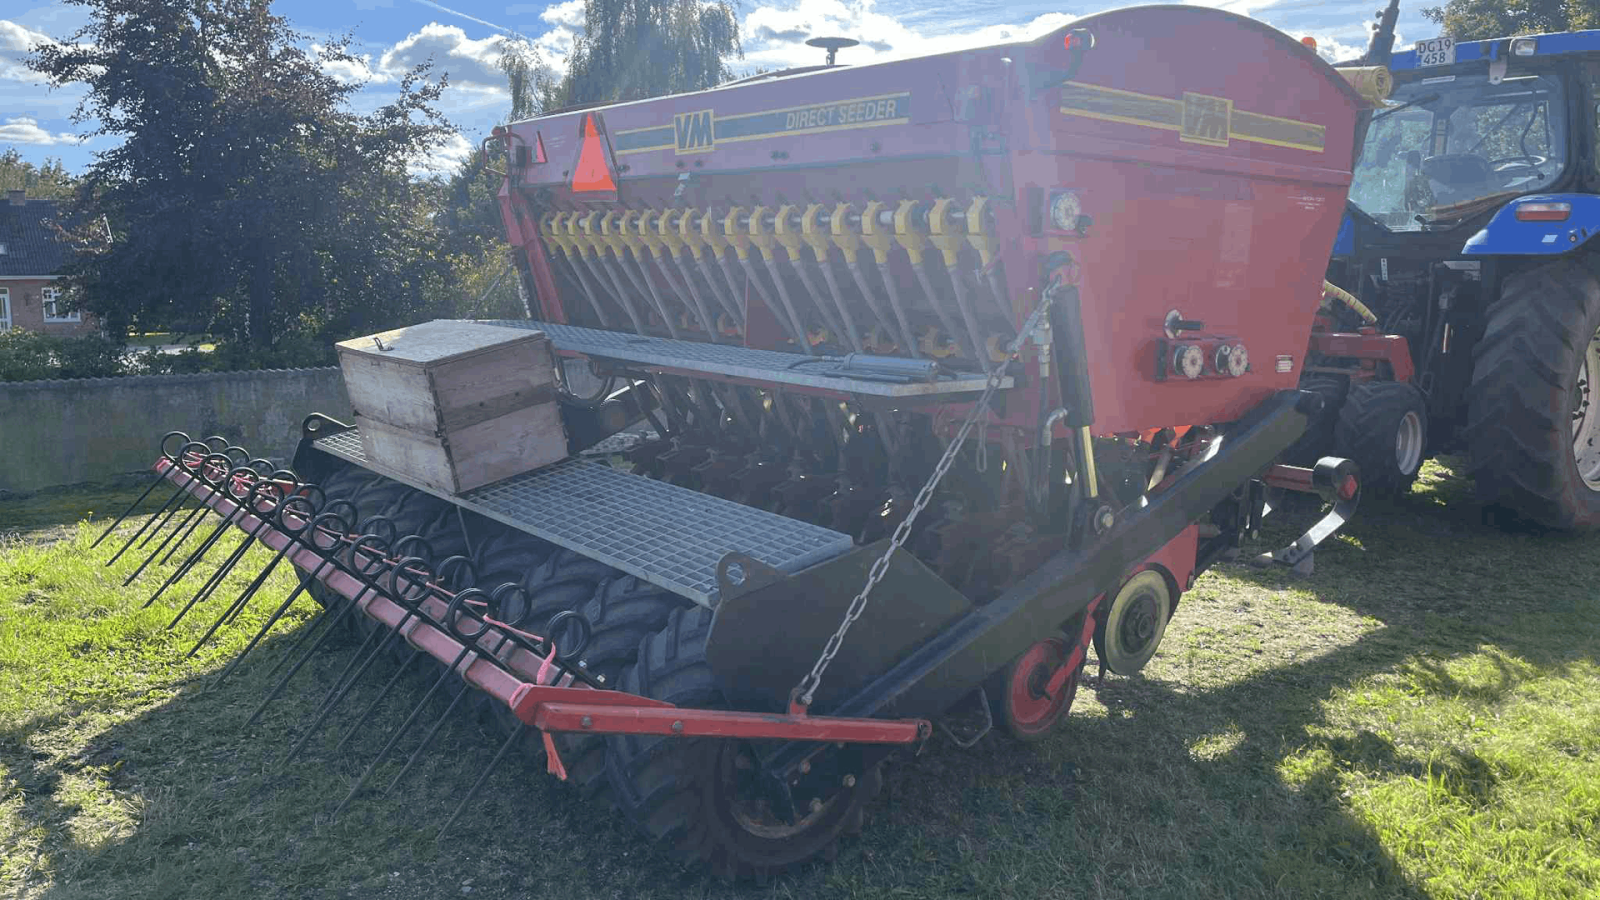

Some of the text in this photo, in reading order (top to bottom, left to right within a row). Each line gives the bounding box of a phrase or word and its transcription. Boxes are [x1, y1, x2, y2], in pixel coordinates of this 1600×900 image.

[1423, 52, 1446, 64] 458
[785, 99, 896, 130] DIRECT SEEDER
[675, 110, 714, 151] VM
